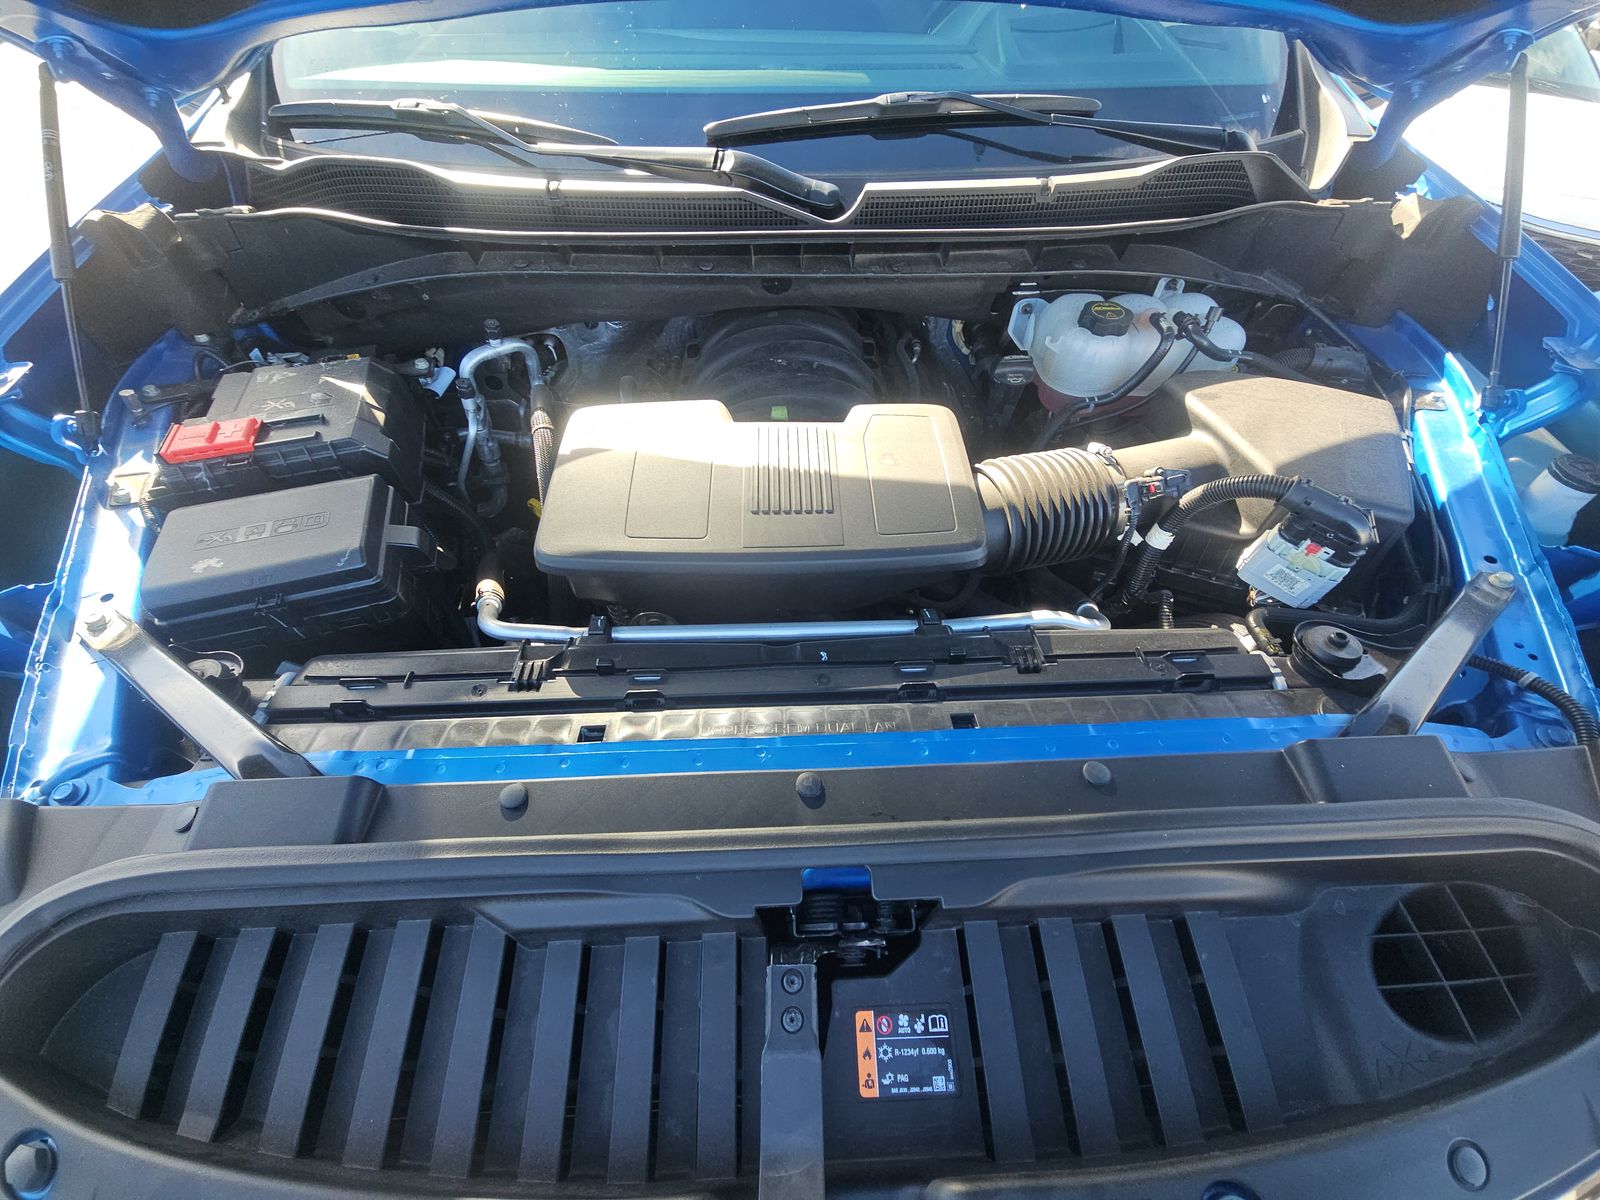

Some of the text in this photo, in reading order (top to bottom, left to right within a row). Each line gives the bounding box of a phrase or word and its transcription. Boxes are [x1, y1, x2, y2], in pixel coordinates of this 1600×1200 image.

[815, 721, 861, 734] DUAL
[894, 1048, 919, 1056] R-1234yf
[938, 1047, 945, 1056] kg
[897, 1074, 909, 1082] PAG
